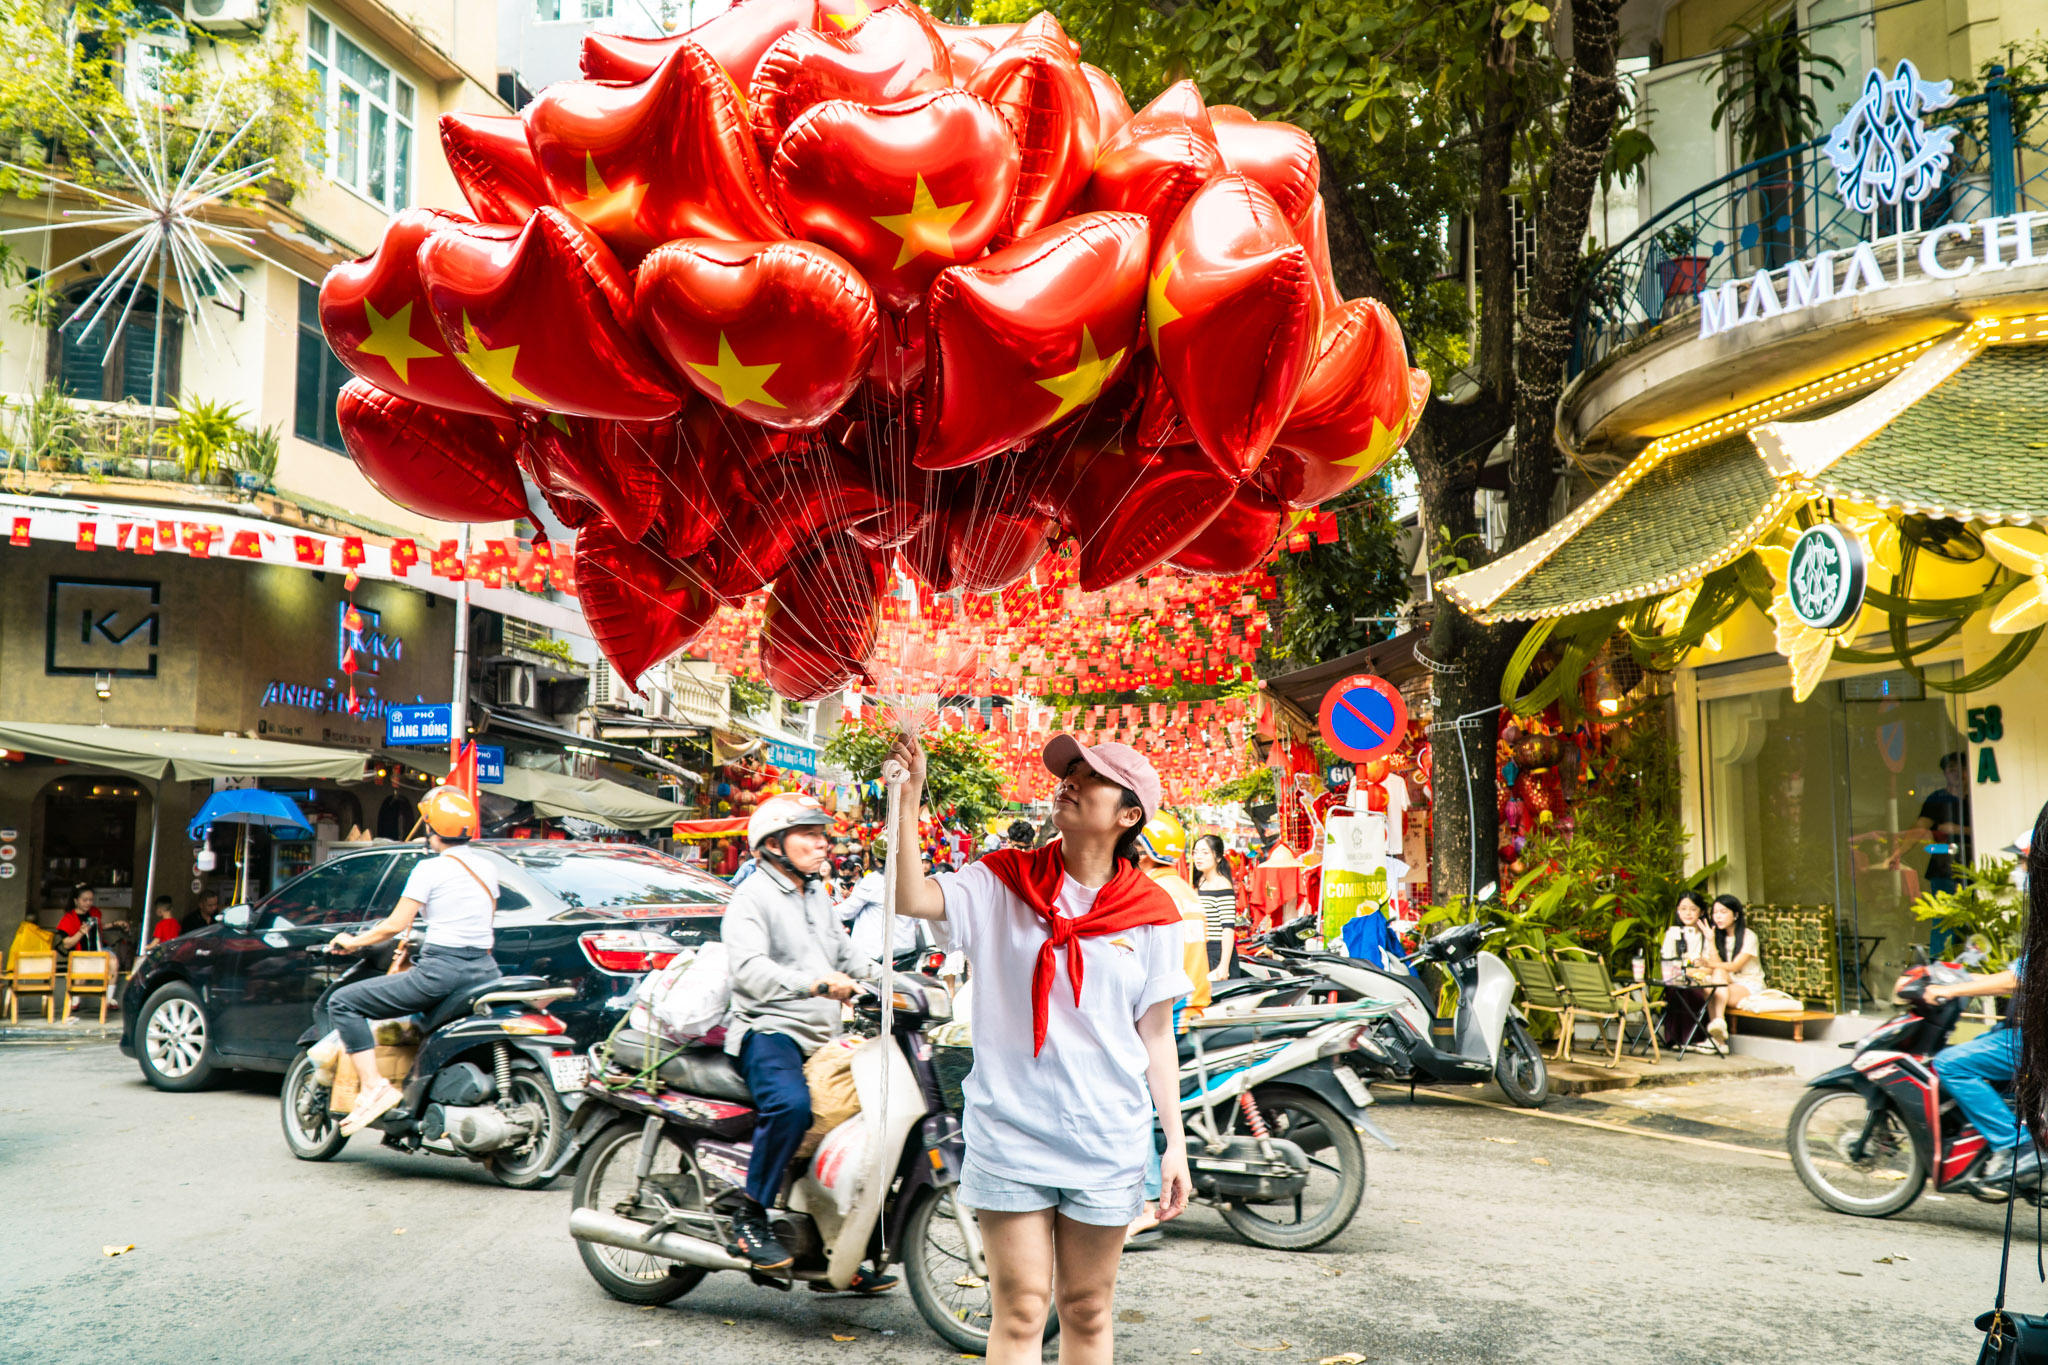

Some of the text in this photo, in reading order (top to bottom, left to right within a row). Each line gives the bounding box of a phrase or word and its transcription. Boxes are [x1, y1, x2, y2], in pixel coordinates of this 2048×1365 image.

[1699, 211, 2048, 340] MAMA CH
[392, 722, 419, 737] HÀNG
[1967, 705, 2003, 743] 58
[1330, 766, 1354, 783] 60
[1977, 747, 2001, 783] A
[1326, 880, 1387, 898] COMING SOON
